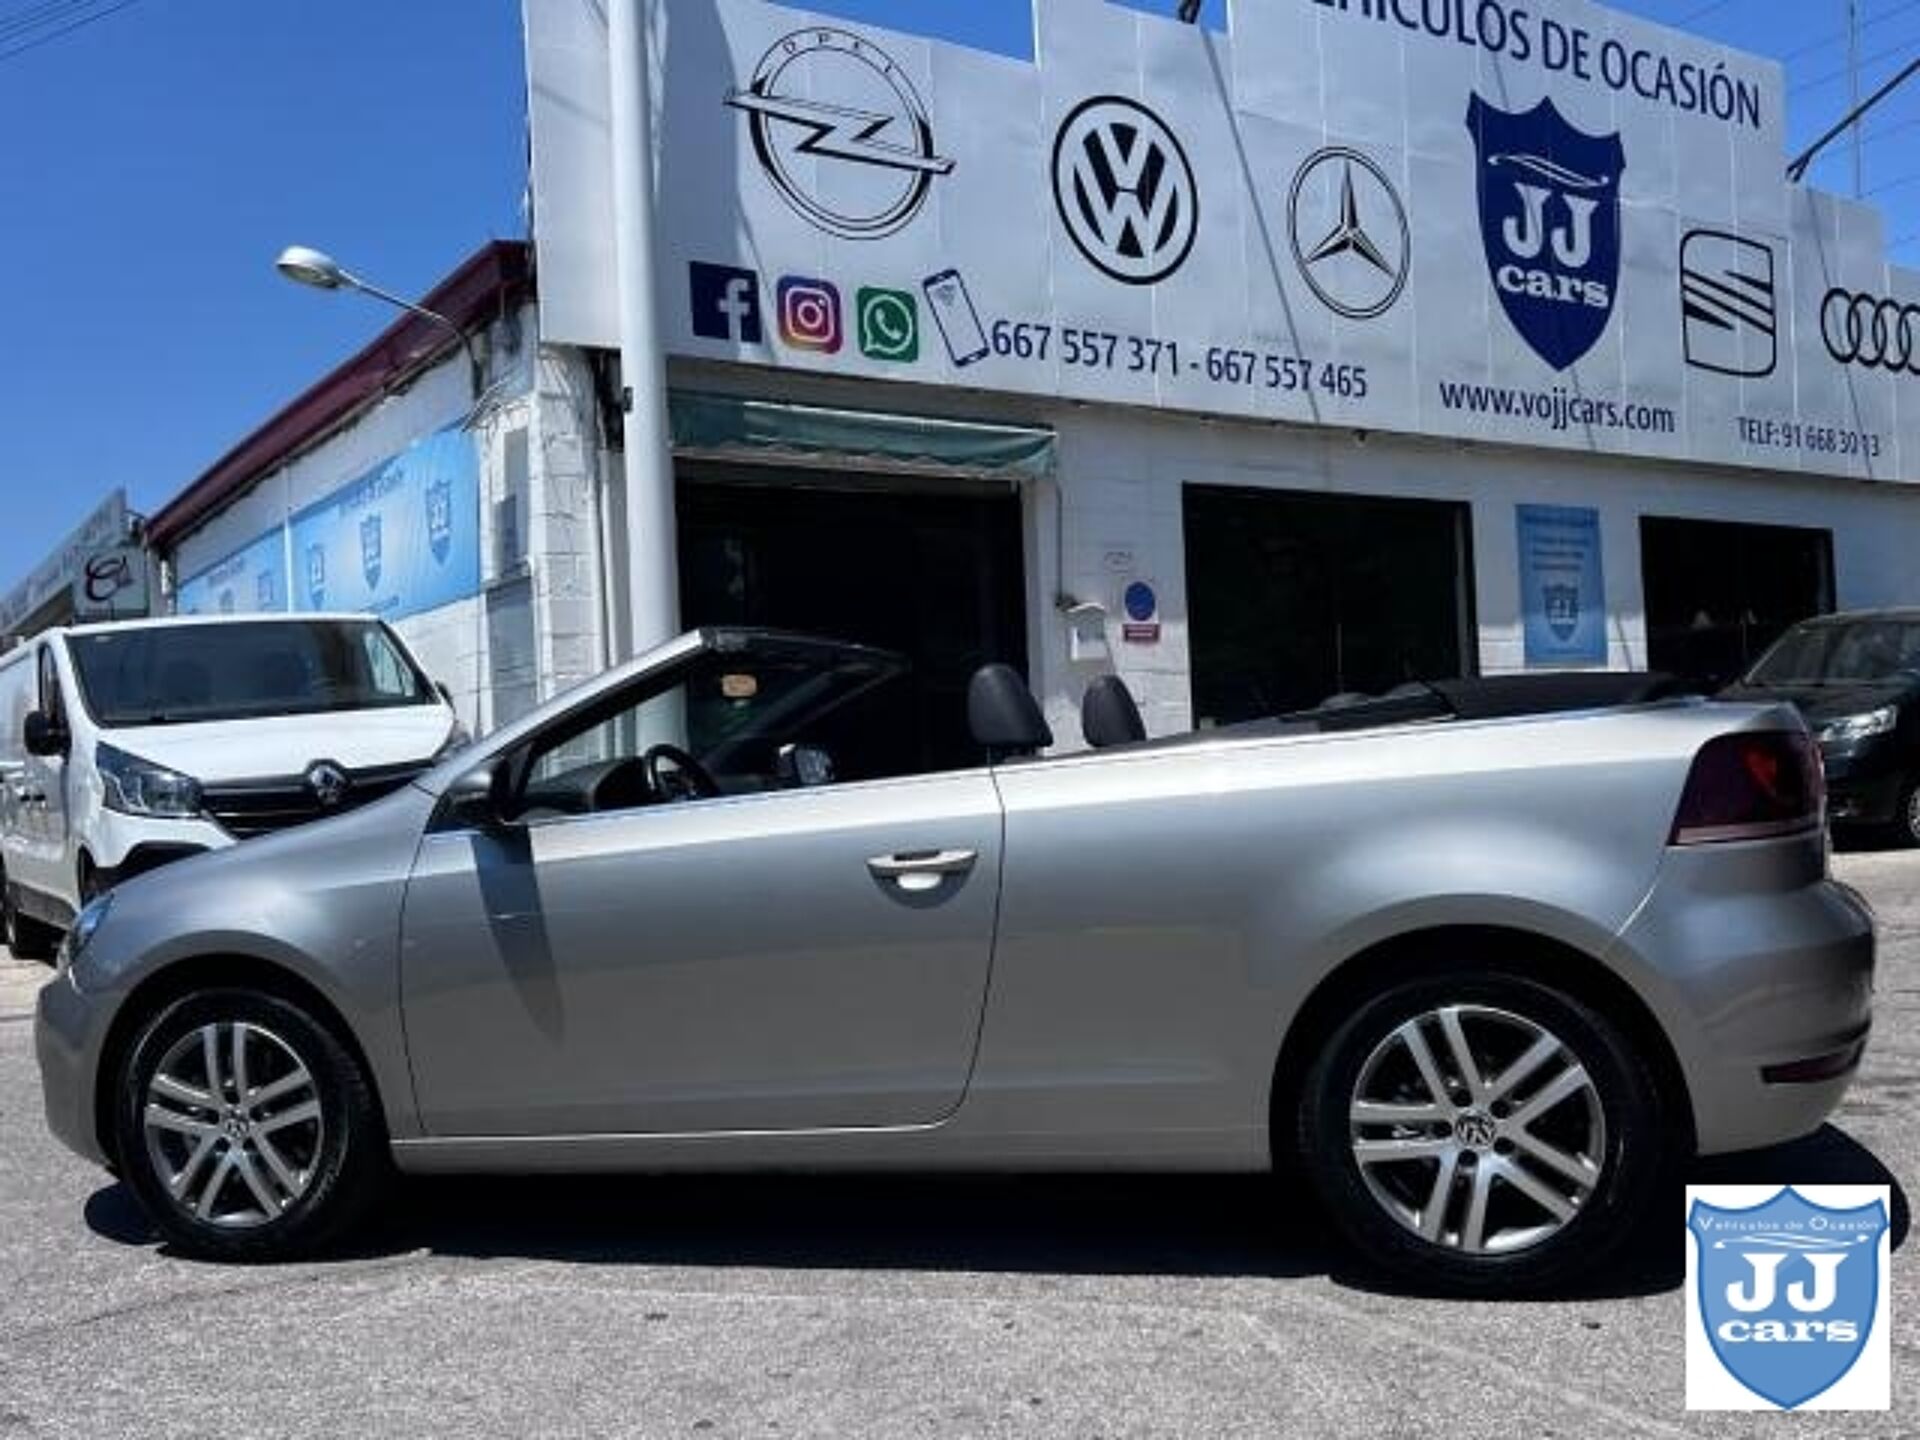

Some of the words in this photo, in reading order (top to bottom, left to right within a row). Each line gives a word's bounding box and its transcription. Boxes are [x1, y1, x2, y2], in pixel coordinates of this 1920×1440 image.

[1542, 19, 1592, 81] DE
[1601, 39, 1761, 129] OCASIÓN
[1502, 182, 1600, 268] JJ
[1500, 265, 1609, 308] cars
[991, 320, 1051, 361] 667
[1063, 329, 1117, 370] 557
[1128, 336, 1179, 376] 371
[1206, 347, 1256, 385] 667
[1265, 355, 1312, 391] 557
[1319, 361, 1367, 398] 465
[1439, 380, 1675, 433] www.vojjcars.com
